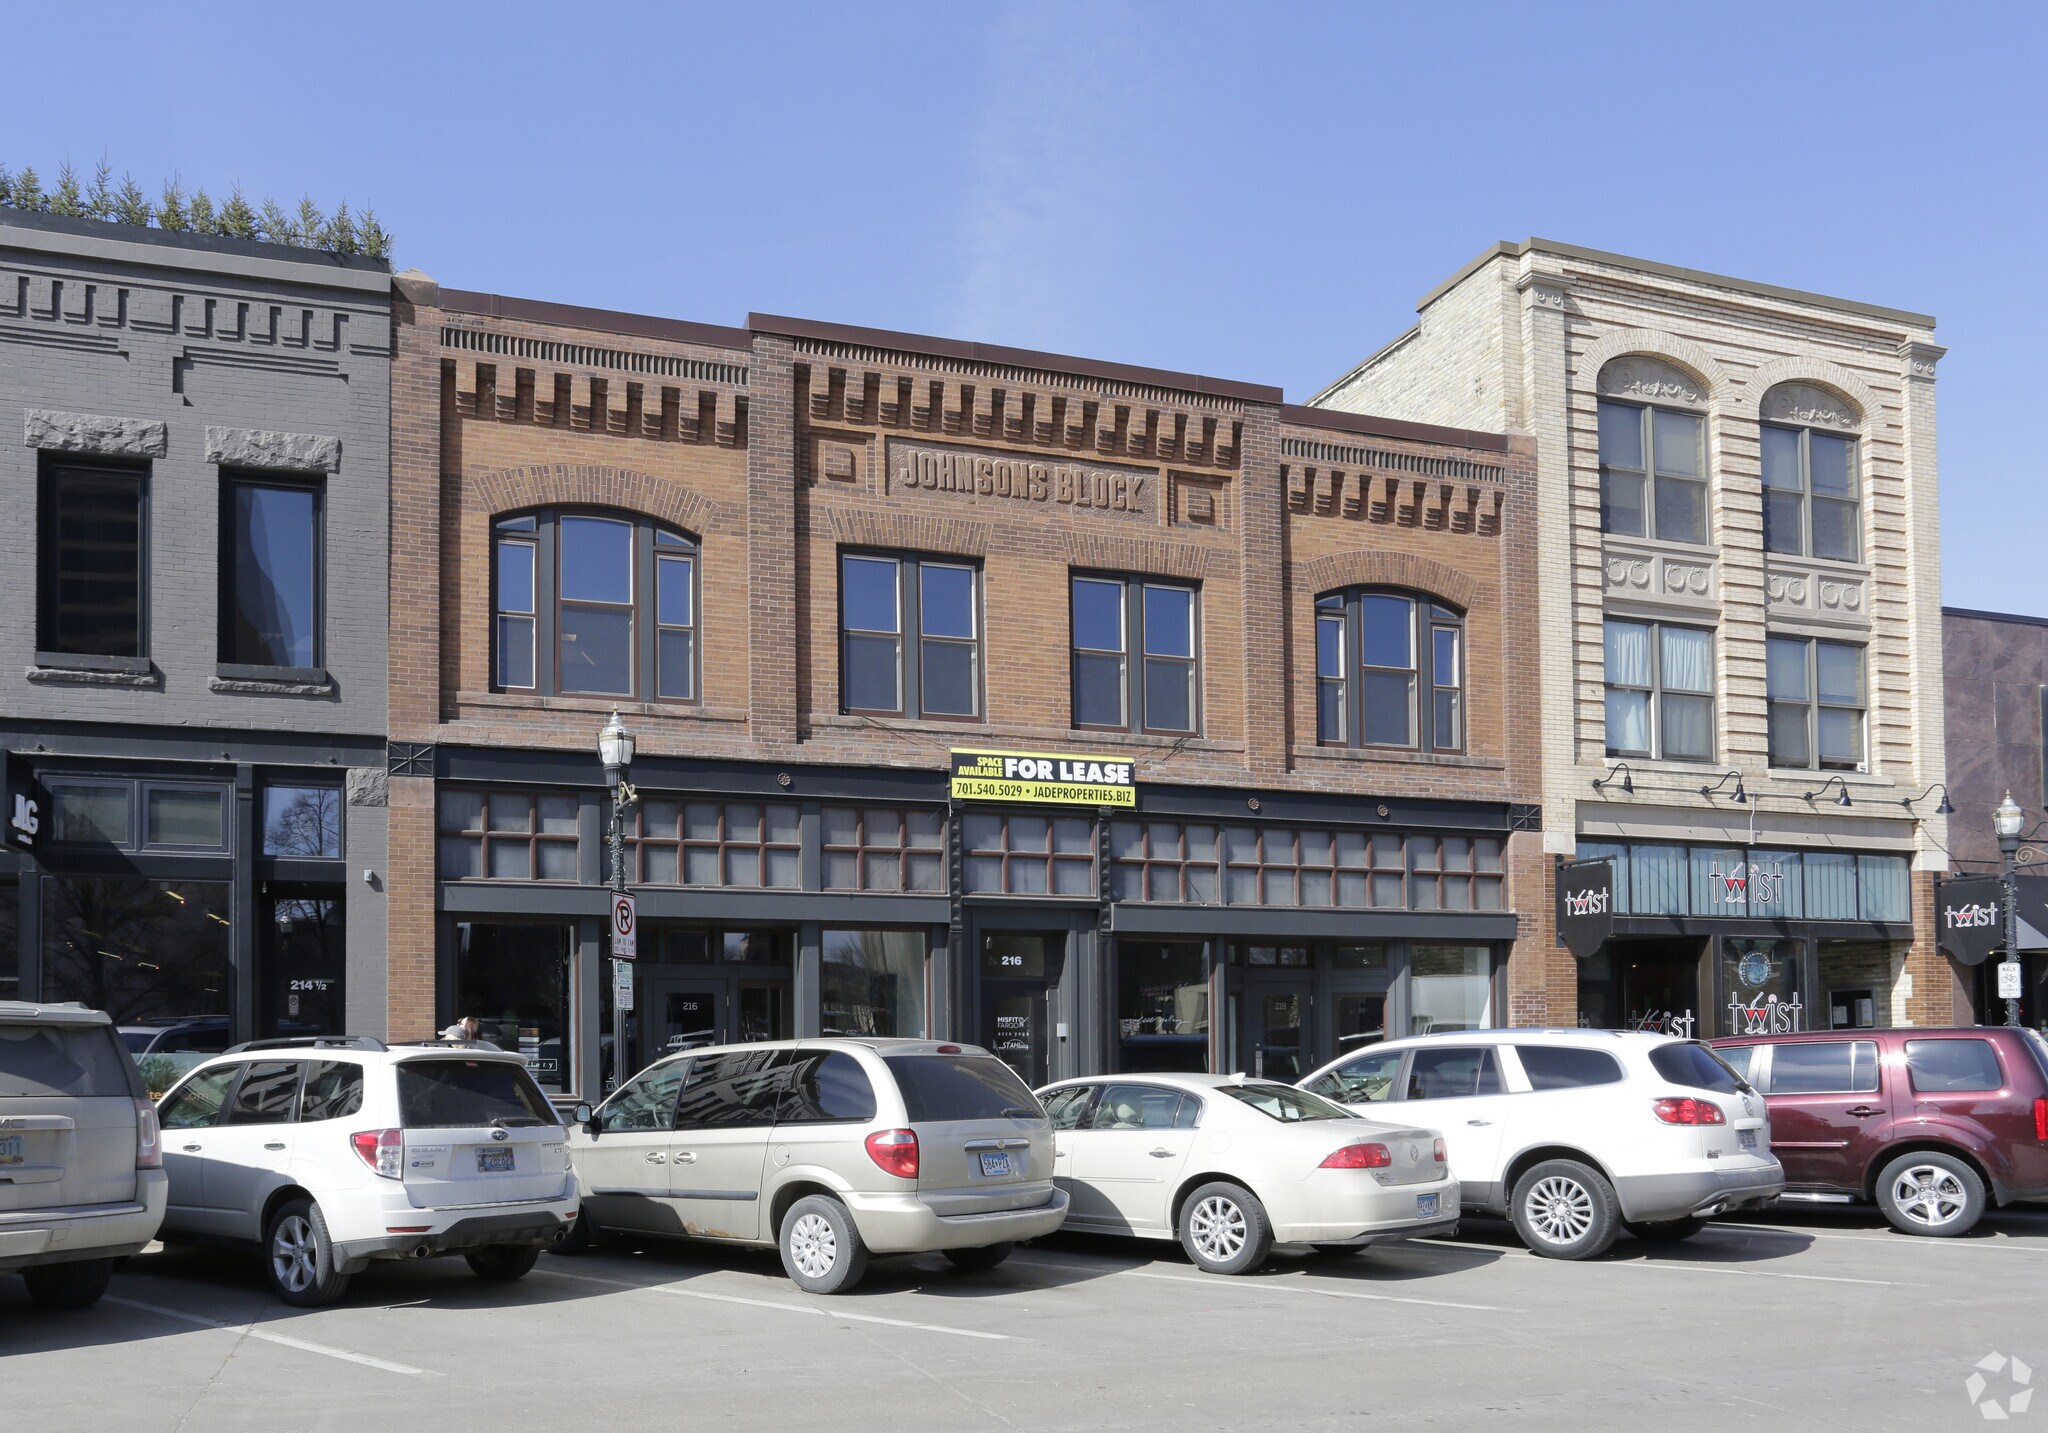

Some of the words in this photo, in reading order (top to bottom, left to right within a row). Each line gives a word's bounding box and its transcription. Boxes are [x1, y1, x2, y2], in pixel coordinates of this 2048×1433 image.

[900, 450, 1048, 502] JOHNSONS
[1055, 466, 1144, 512] BLOCK
[957, 765, 1003, 777] AVAILABLE
[976, 756, 1003, 767] SPACE
[1004, 758, 1054, 780] FOR
[1059, 761, 1130, 784] LEASE
[956, 782, 1022, 797] 701.540.5029
[1033, 786, 1132, 802] JADEPROPERTIES.BIZ
[11, 793, 39, 835] JLG
[1709, 861, 1784, 904] twist
[1565, 886, 1609, 917] twist
[1944, 901, 1999, 929] twist
[1001, 955, 1023, 966] 216
[290, 980, 313, 990] 214
[682, 1002, 698, 1011] 216
[1275, 1002, 1287, 1010] 218
[1728, 991, 1803, 1035] twist
